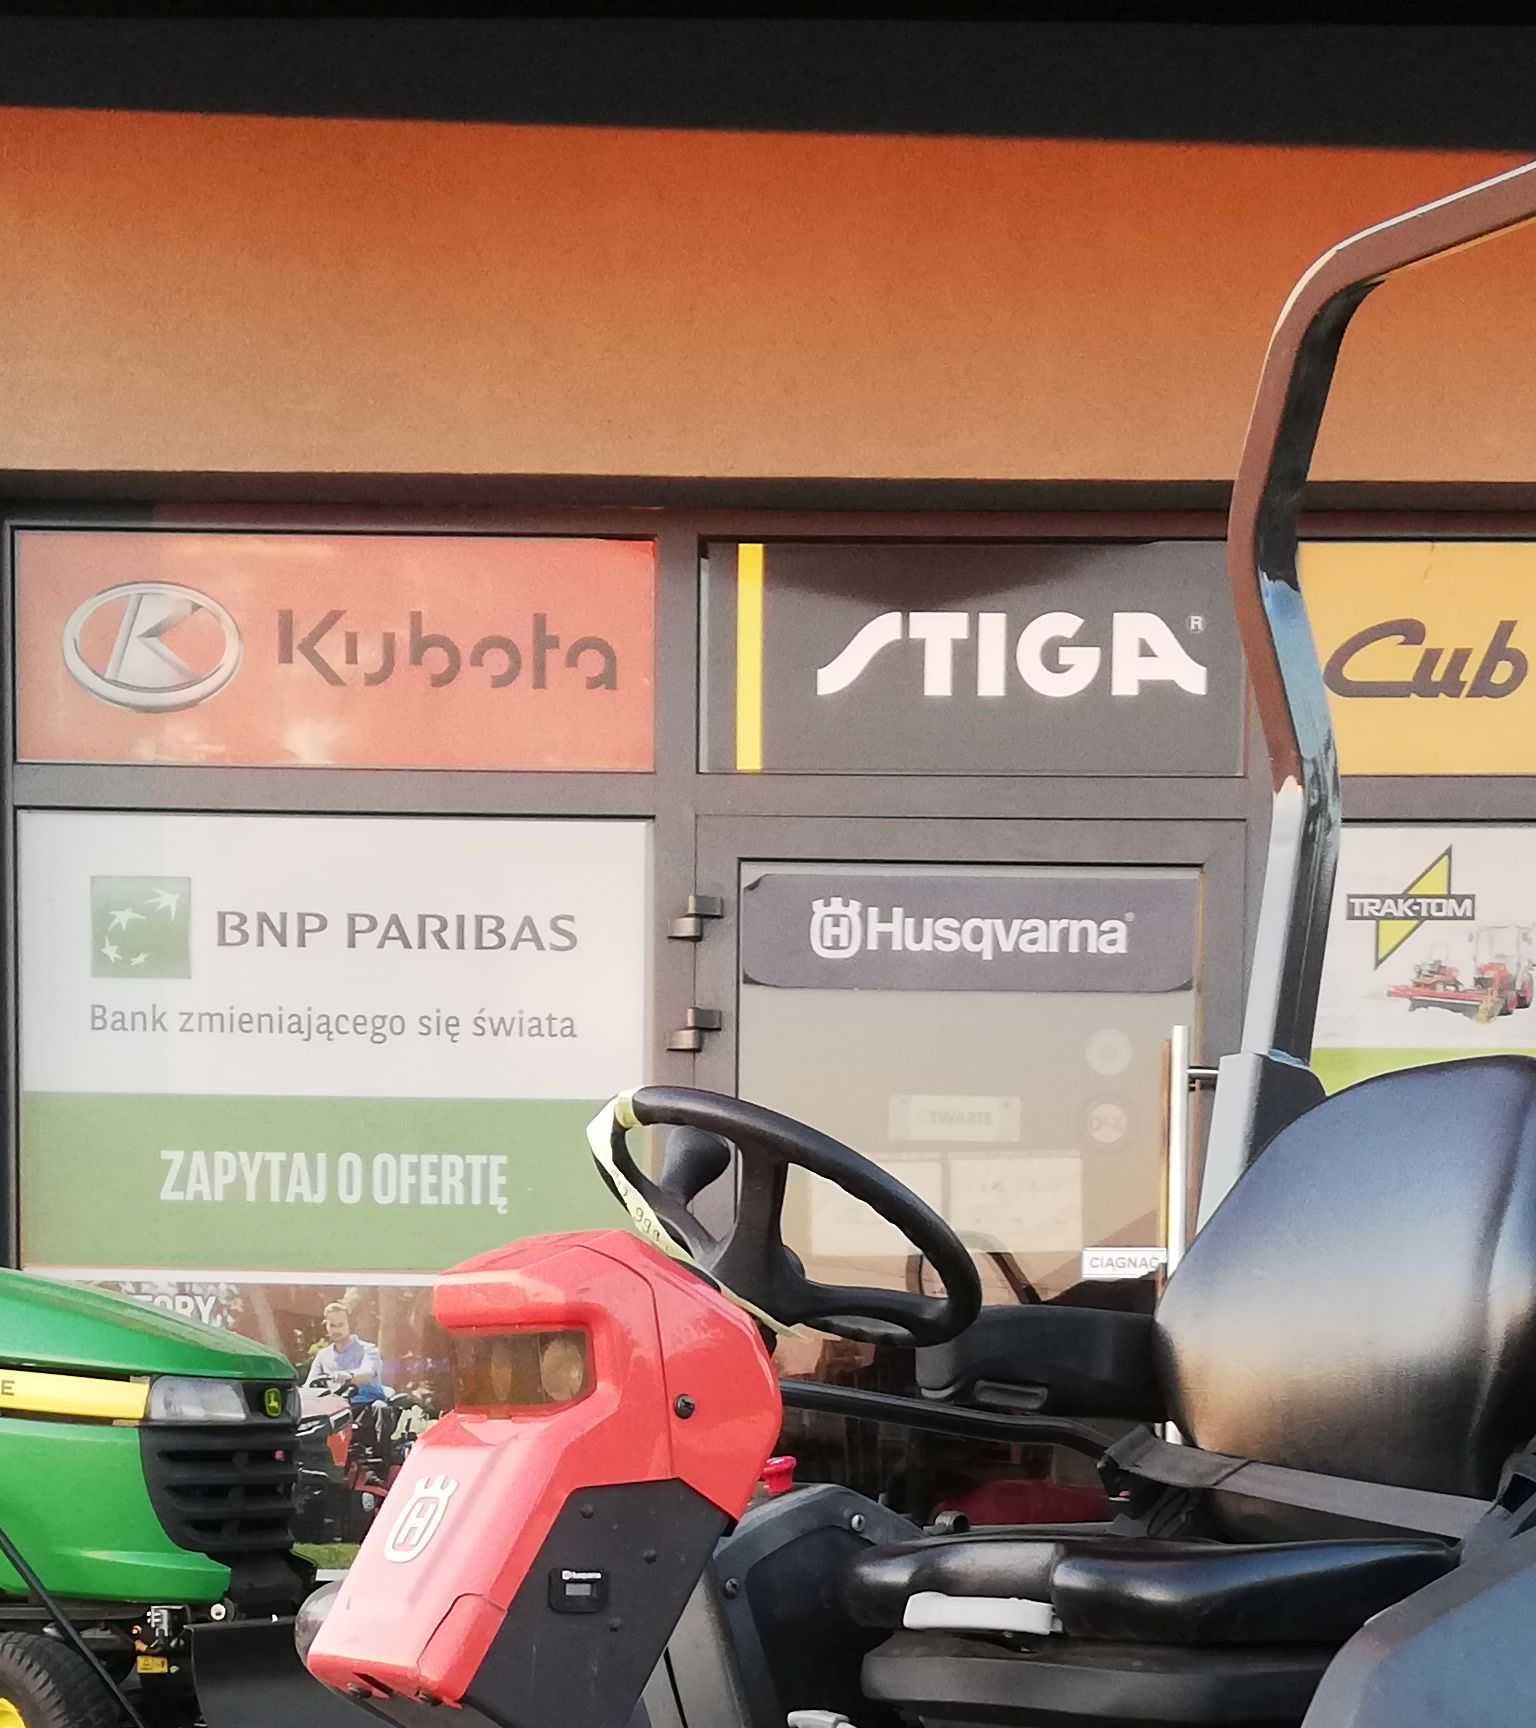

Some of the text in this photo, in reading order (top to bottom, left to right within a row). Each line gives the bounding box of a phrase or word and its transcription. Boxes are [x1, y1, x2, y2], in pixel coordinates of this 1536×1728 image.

[278, 609, 617, 690] Kubota
[817, 612, 1207, 697] STIGA
[1323, 619, 1528, 699] Cub
[216, 911, 578, 952] BNP PARIBAS
[866, 907, 1129, 960] Husqvarna
[1349, 898, 1473, 917] TRAK-TOM
[90, 1004, 577, 1044] Bank zmieniającego się świata
[160, 1149, 509, 1214] ZAPYTAJ O OFERTĘ
